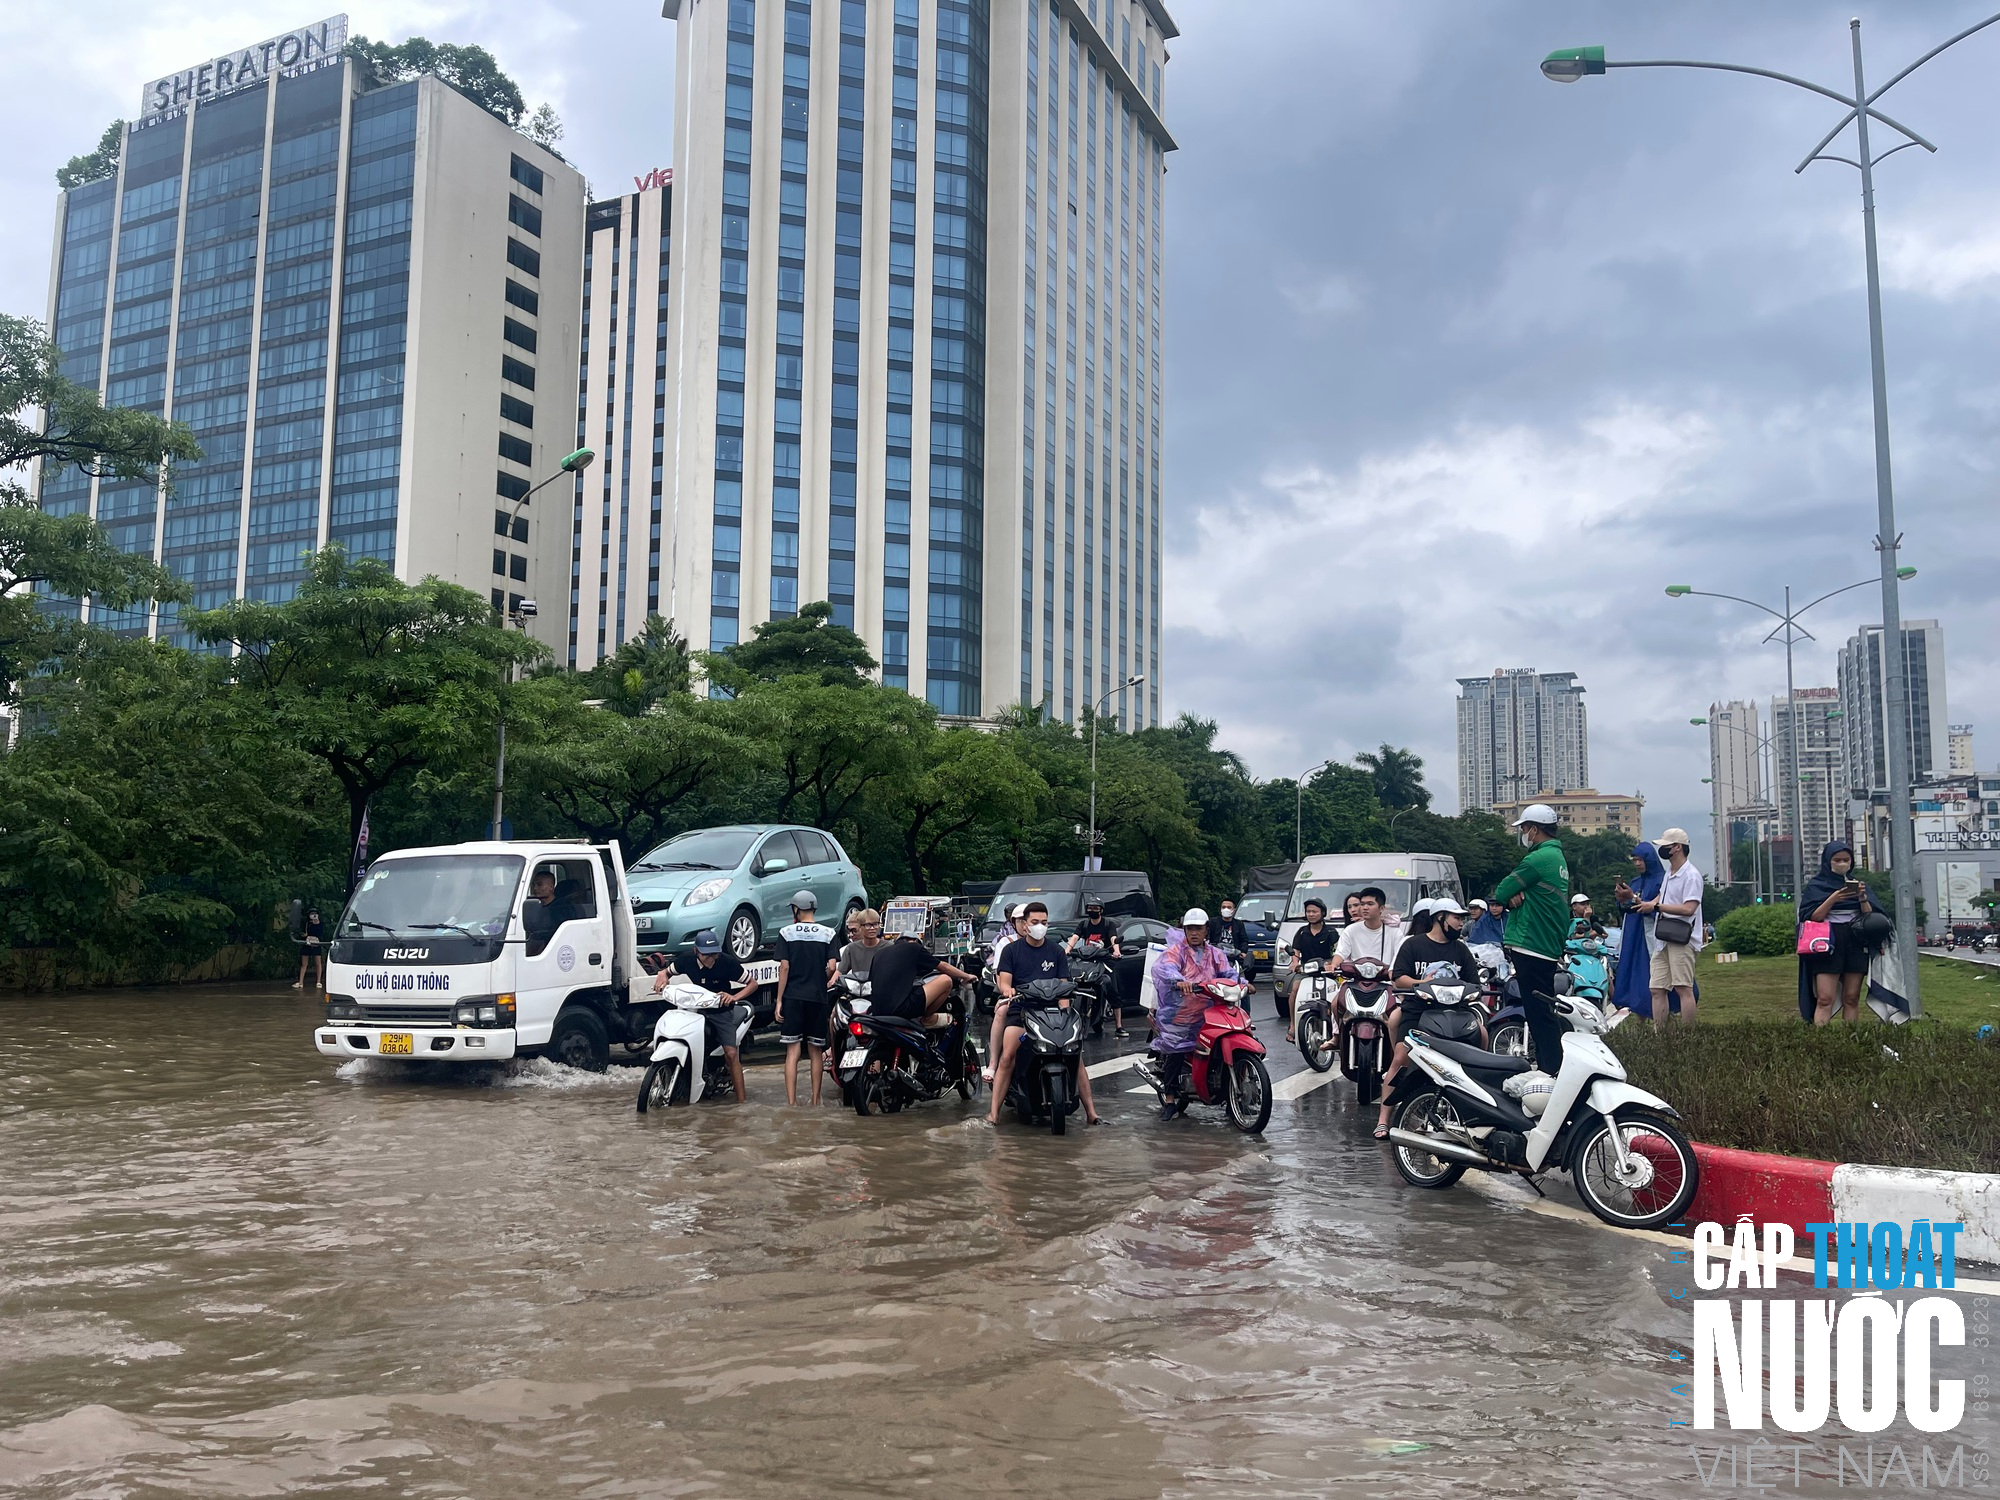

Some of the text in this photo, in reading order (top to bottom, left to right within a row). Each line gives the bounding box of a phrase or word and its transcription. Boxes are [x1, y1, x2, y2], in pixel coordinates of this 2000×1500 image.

[153, 22, 328, 110] SHERATON
[1925, 831, 1968, 842] THIEN
[795, 925, 819, 933] D&G
[383, 948, 430, 959] ISUZU
[355, 969, 450, 993] CỨU HỘ GIAO THÔNG
[388, 1034, 404, 1043] 29H
[382, 1043, 408, 1053] 038.04
